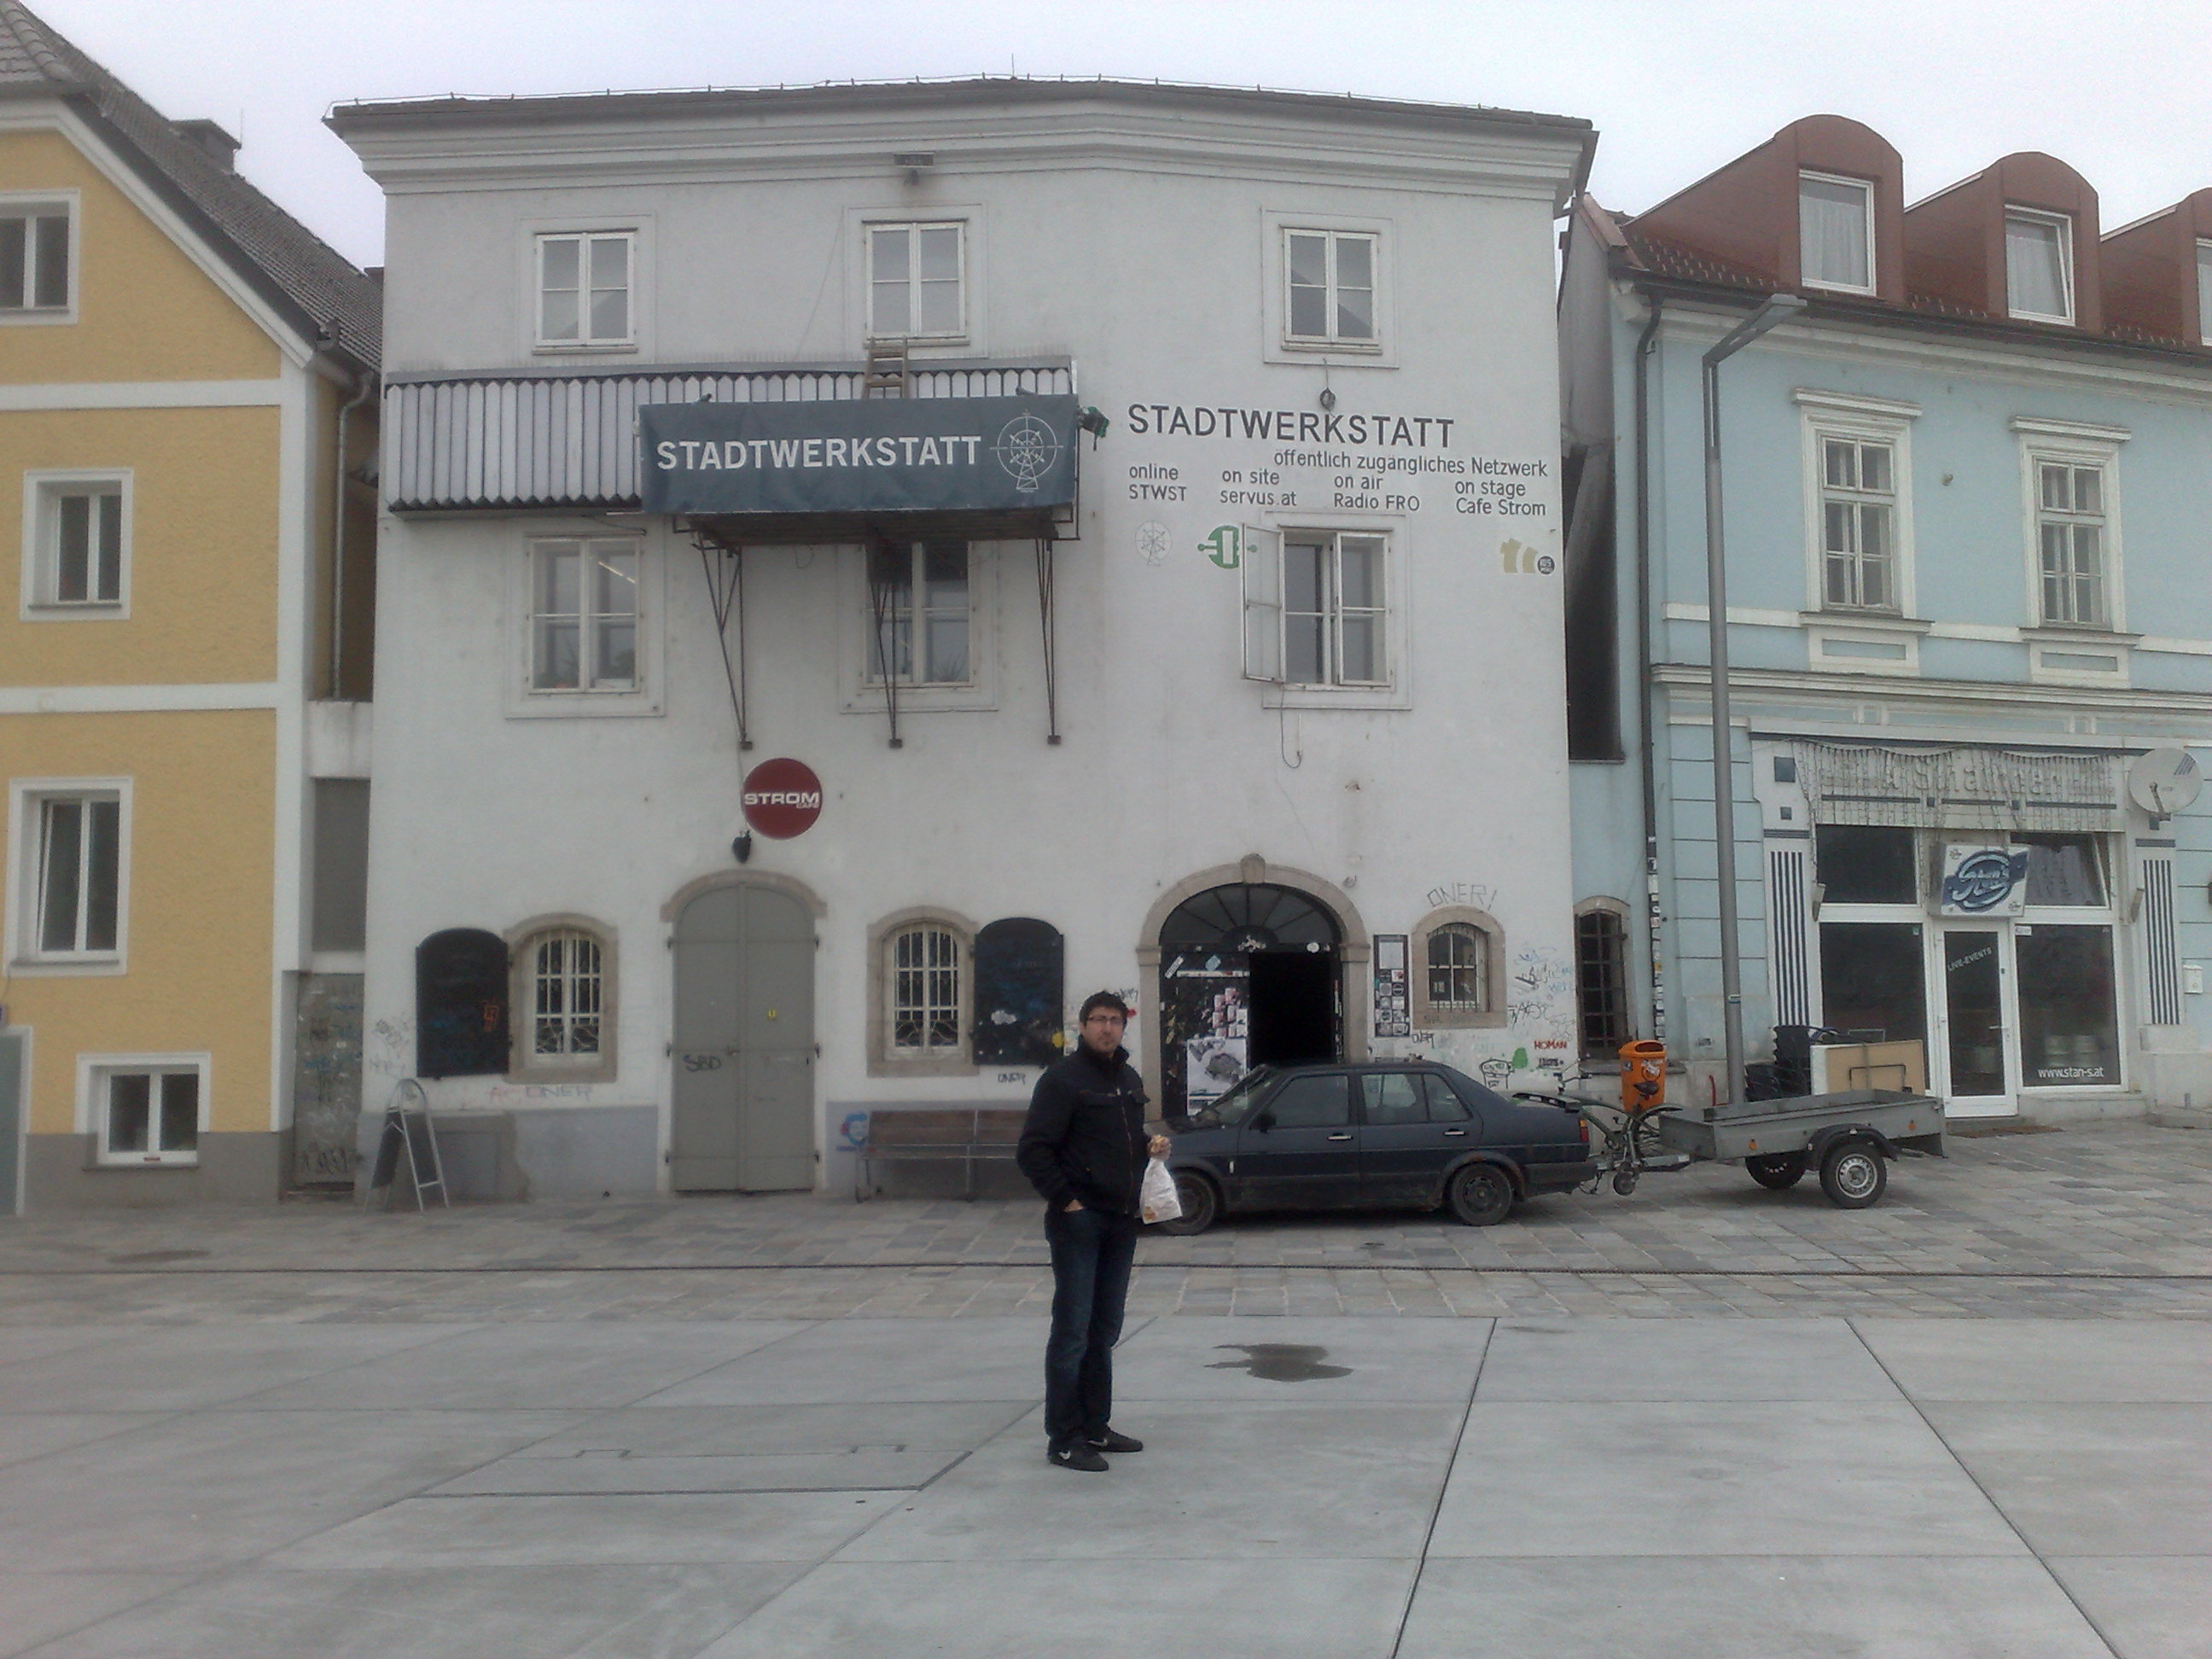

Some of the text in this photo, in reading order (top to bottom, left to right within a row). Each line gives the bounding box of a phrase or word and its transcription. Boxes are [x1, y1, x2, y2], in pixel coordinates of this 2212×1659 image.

[1127, 403, 1454, 448] STADTWERKSTATT
[656, 435, 981, 471] STADTWERKSTATT
[1129, 463, 1179, 480] online
[1274, 449, 1548, 477] öffentlich zugängliches Netzwerk
[1222, 469, 1280, 485] on site
[1334, 474, 1383, 490] on air
[1129, 484, 1187, 501] STWST
[1455, 480, 1526, 499] on stage
[1334, 492, 1421, 511] Radio FRO
[1456, 498, 1545, 515] Cafe Strom
[744, 792, 819, 805] STROM
[1947, 947, 1993, 971] LIVE-EVENTS
[2037, 1066, 2104, 1079] www.stan-s.at
